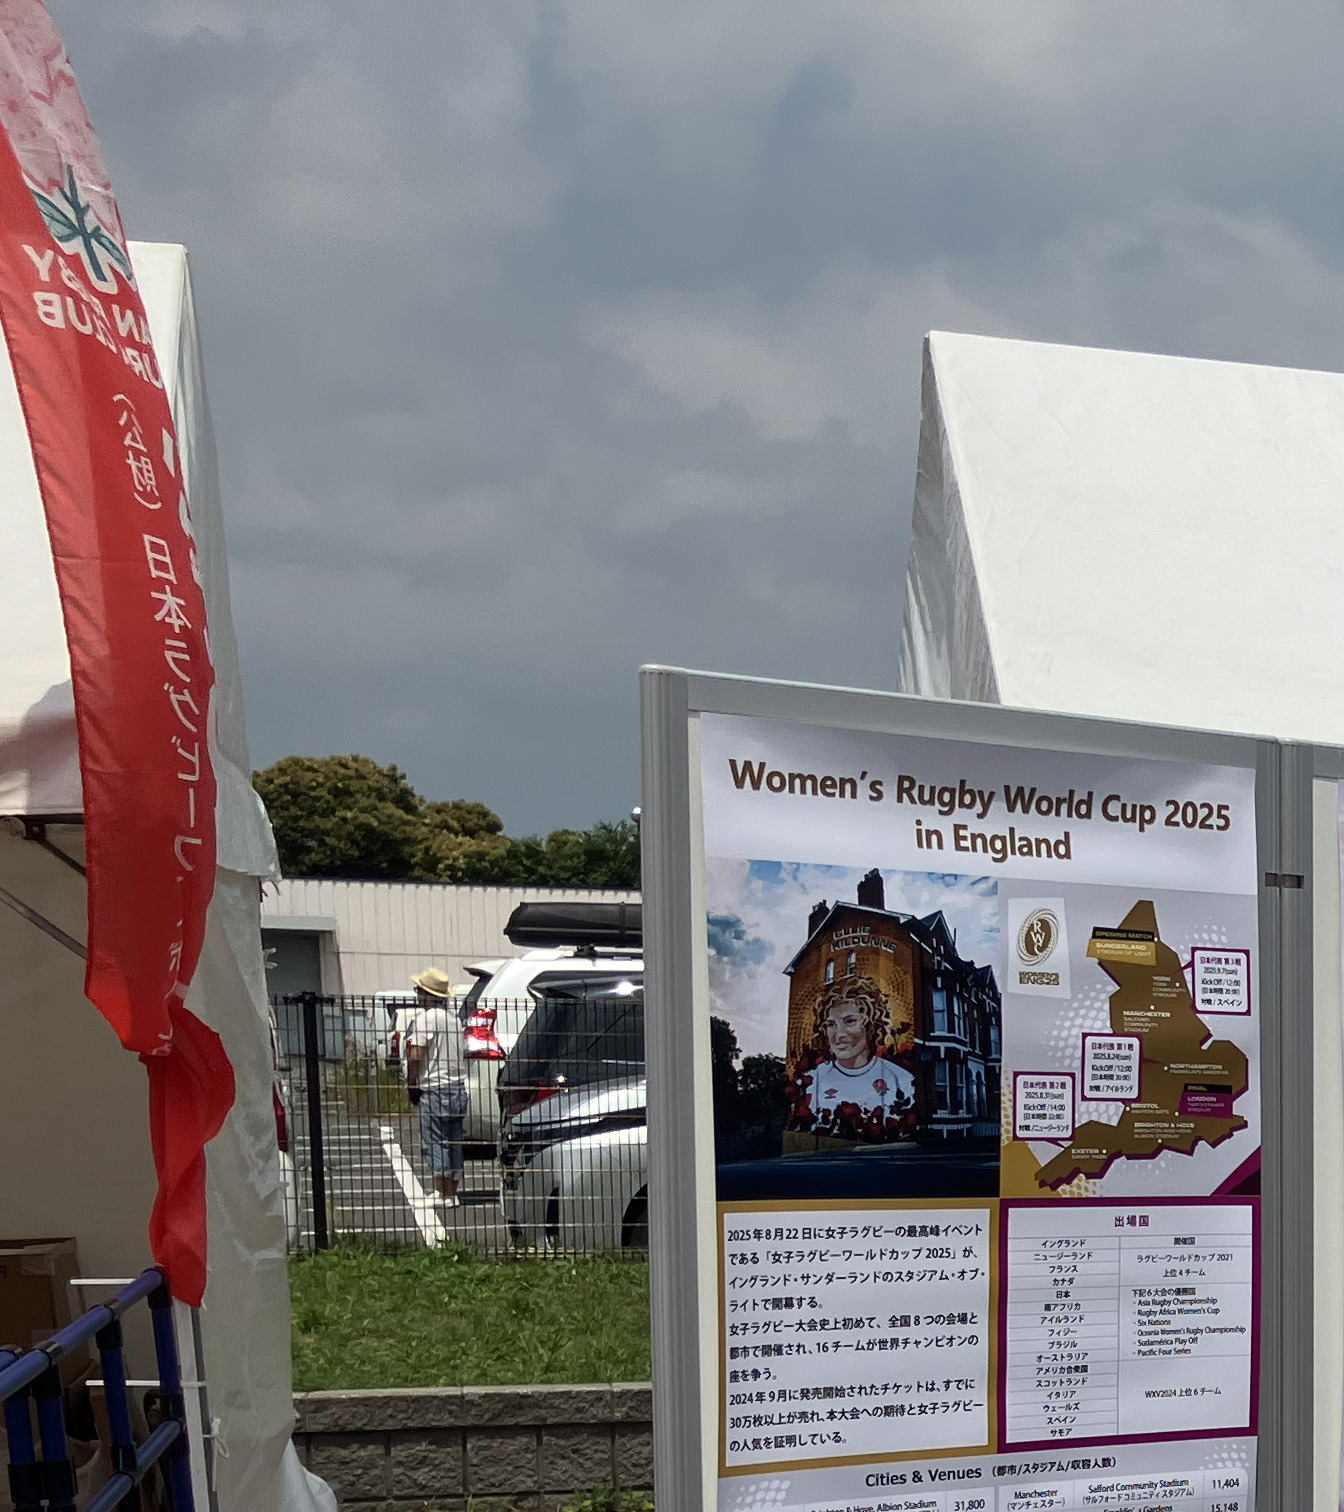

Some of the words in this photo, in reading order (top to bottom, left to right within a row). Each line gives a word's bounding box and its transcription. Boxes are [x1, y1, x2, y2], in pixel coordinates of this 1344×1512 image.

[728, 759, 884, 801] Women's
[897, 775, 994, 818] Rugby
[1003, 785, 1093, 820] World
[1101, 795, 1157, 831] Cup
[1164, 800, 1230, 831] 2025
[916, 820, 943, 849] in
[953, 824, 1071, 863] England
[1115, 1215, 1149, 1227] 出場国
[1041, 1239, 1086, 1247] イングランド
[1034, 1252, 1093, 1261] ニュージーランド
[1217, 1253, 1233, 1262] 2021
[1049, 1264, 1078, 1273] フランス
[1052, 1277, 1074, 1286] カナダ
[1056, 1290, 1071, 1299] 日本
[729, 1297, 823, 1312] ライトで開幕する。
[1040, 1315, 1085, 1324] アイルランド
[1048, 1328, 1077, 1336] フィジー
[1048, 1340, 1078, 1349] ブラジル
[1036, 1352, 1088, 1362] オーストラリア
[729, 1368, 777, 1383] 座を争う。
[1036, 1377, 1088, 1387] スコットランド
[1047, 1390, 1076, 1399] イタリア
[1043, 1403, 1080, 1412] ウェールズ
[1047, 1415, 1076, 1424] スペイン
[1050, 1428, 1072, 1436] サモア
[730, 1431, 847, 1452] の人気を証明している。
[865, 1471, 907, 1487] Cities
[912, 1470, 923, 1484] &
[928, 1467, 982, 1481] Venues
[1212, 1479, 1239, 1488] 11,404
[954, 1499, 985, 1511] 31,800
